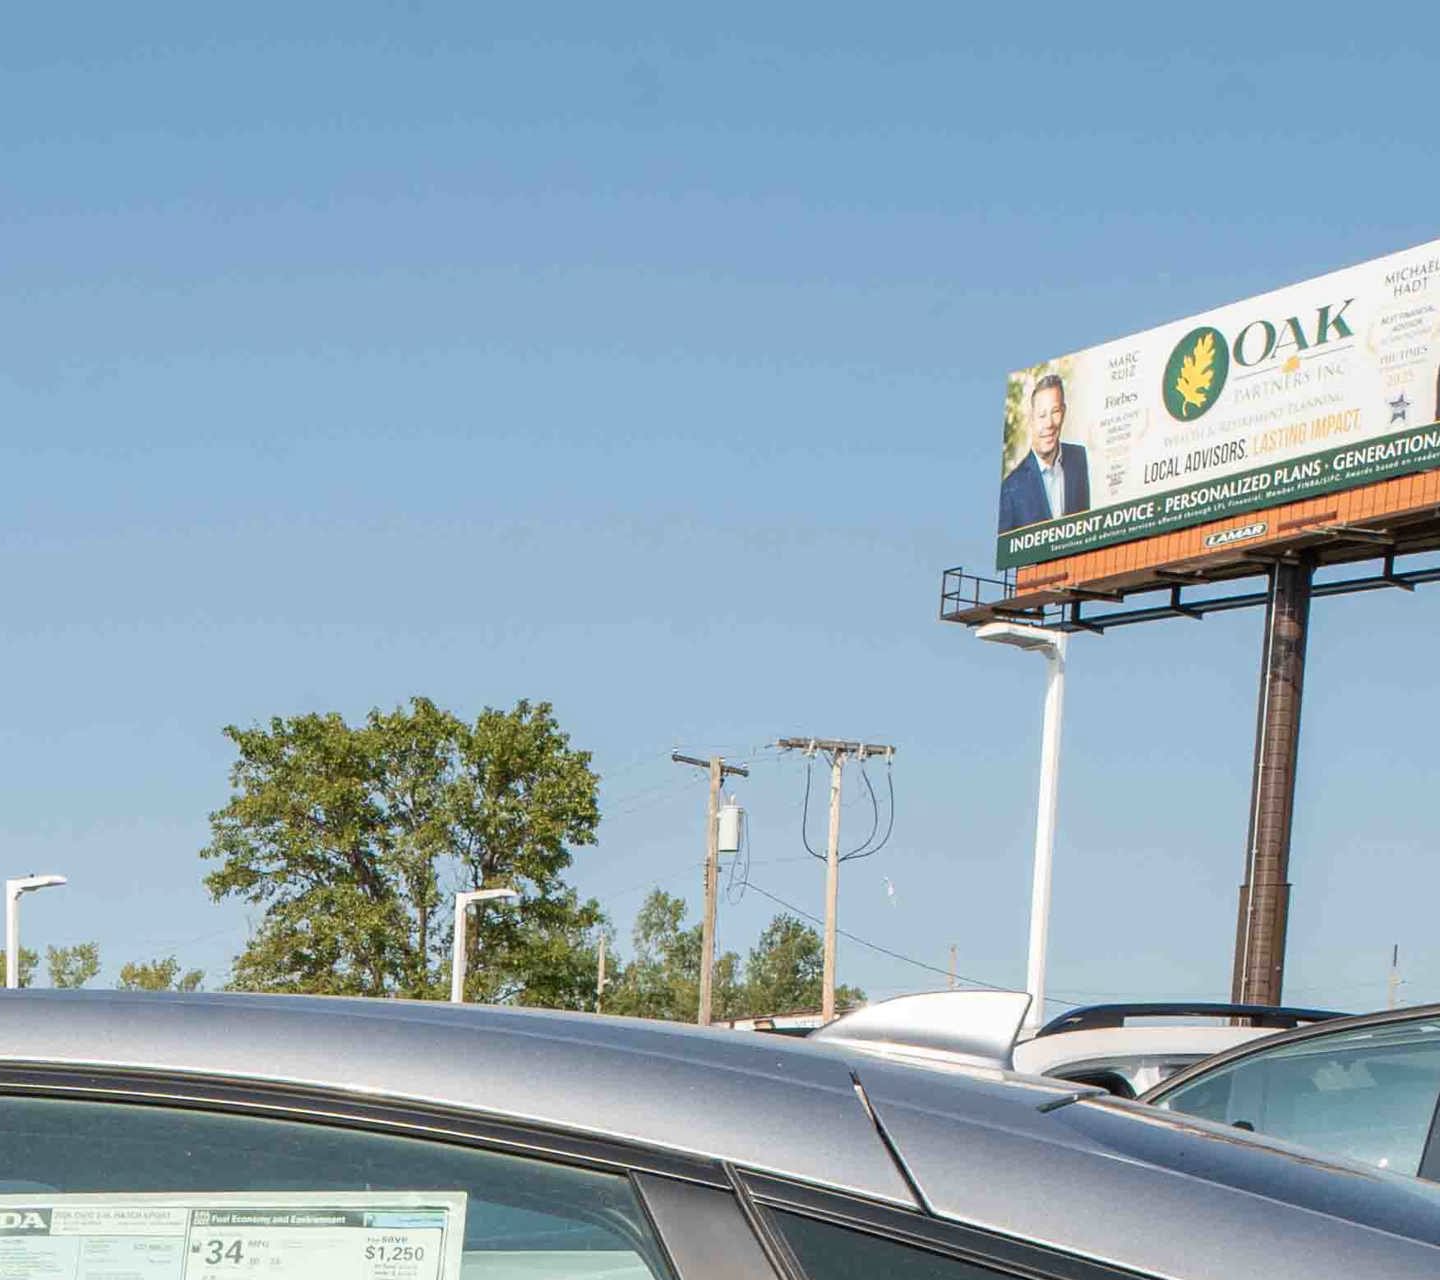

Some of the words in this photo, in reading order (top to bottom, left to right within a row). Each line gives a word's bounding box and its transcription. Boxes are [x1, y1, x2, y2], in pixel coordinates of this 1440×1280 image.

[1384, 256, 1440, 287] MICHAEL
[1393, 276, 1429, 298] HADT
[1232, 297, 1356, 367] OAK
[1109, 349, 1142, 369] MARC
[1110, 364, 1137, 381] RUIZ
[1233, 371, 1312, 404] PARTNERS
[1104, 391, 1139, 410] Forbes
[1287, 392, 1345, 415] PLANNING
[1144, 459, 1180, 484] LOCAL
[1184, 438, 1248, 473] ADVISORS.
[1252, 423, 1308, 455] LASTING
[1010, 515, 1104, 553] INDEPENDENT
[1103, 502, 1155, 529] ADVICE
[1165, 473, 1271, 514] PERSONALIZED
[1274, 459, 1321, 486] PLANS
[1085, 535, 1098, 544] and
[1128, 521, 1156, 533] services
[1158, 513, 1182, 526] offered
[1184, 505, 1212, 520] through
[1265, 485, 1295, 499] Member
[1345, 467, 1373, 480] Awards
[1375, 460, 1399, 472] based
[1401, 457, 1412, 467] on
[1414, 450, 1440, 463] reader
[1208, 523, 1264, 547] LAMAR
[211, 1214, 230, 1225] Fuel
[231, 1214, 271, 1226] Economy
[272, 1214, 289, 1225] and
[290, 1214, 346, 1225] Environment
[204, 1239, 244, 1265] 34
[364, 1246, 425, 1263] $1,250
